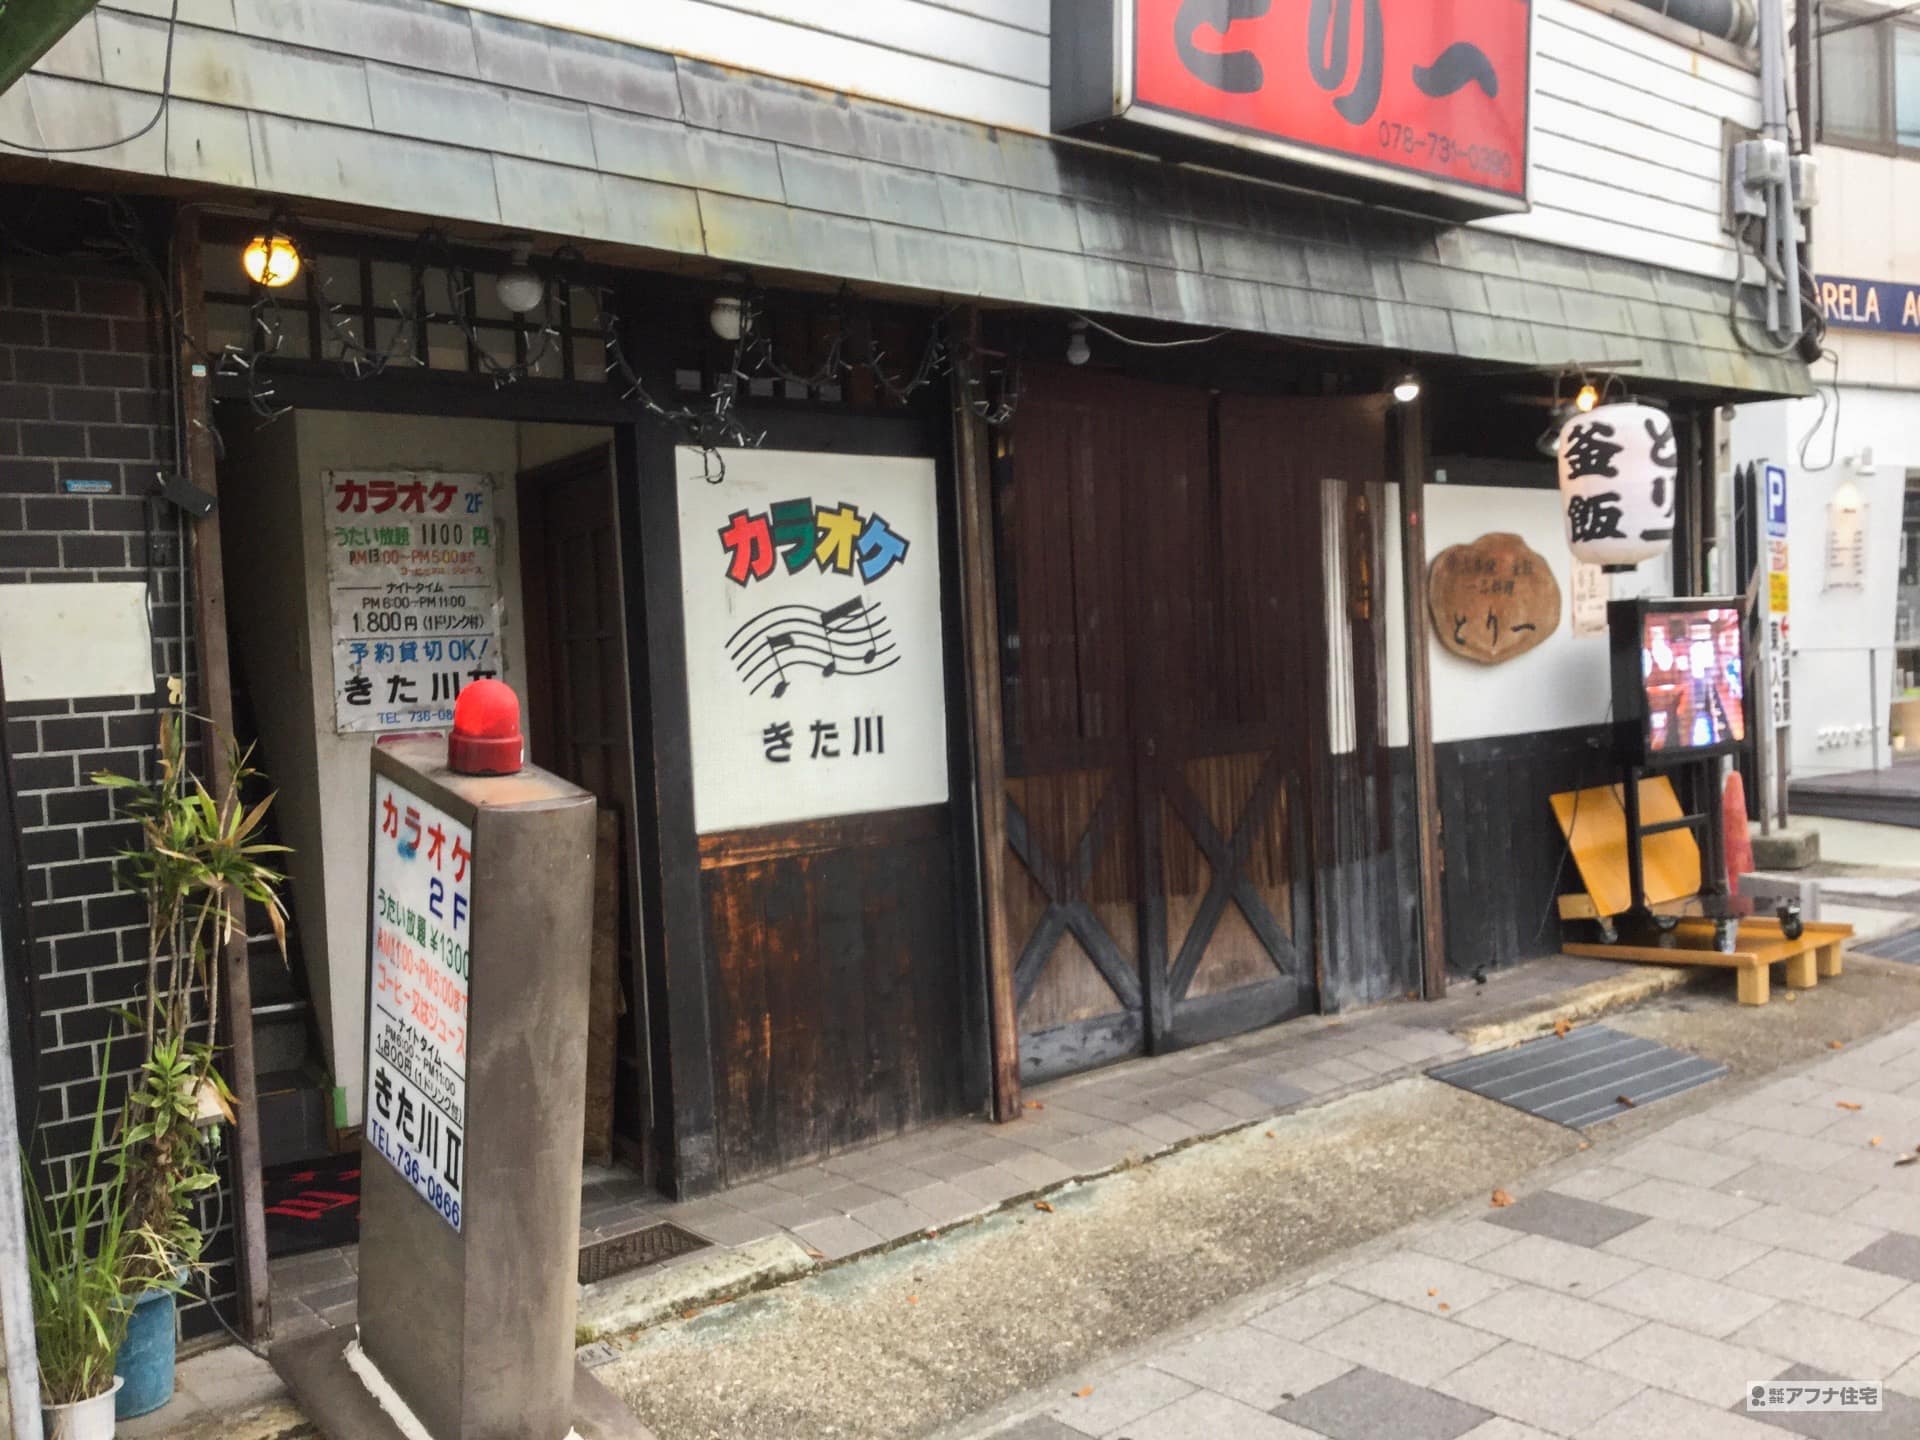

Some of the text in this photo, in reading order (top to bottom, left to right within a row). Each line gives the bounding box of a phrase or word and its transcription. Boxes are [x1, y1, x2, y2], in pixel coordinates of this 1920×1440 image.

[1815, 282, 1881, 325] RELA
[335, 479, 484, 514] カラオケ 2F
[1566, 420, 1627, 543] 釜飯
[334, 523, 490, 547] うたい放題 1100 円
[718, 497, 910, 588] カラオケ
[377, 709, 456, 724] TEL 736-08
[762, 715, 885, 763] きた川
[382, 792, 471, 882] カラオケ
[377, 888, 426, 948] うたい放題
[429, 876, 468, 930] 2F
[398, 1017, 442, 1067] ナイトタイム
